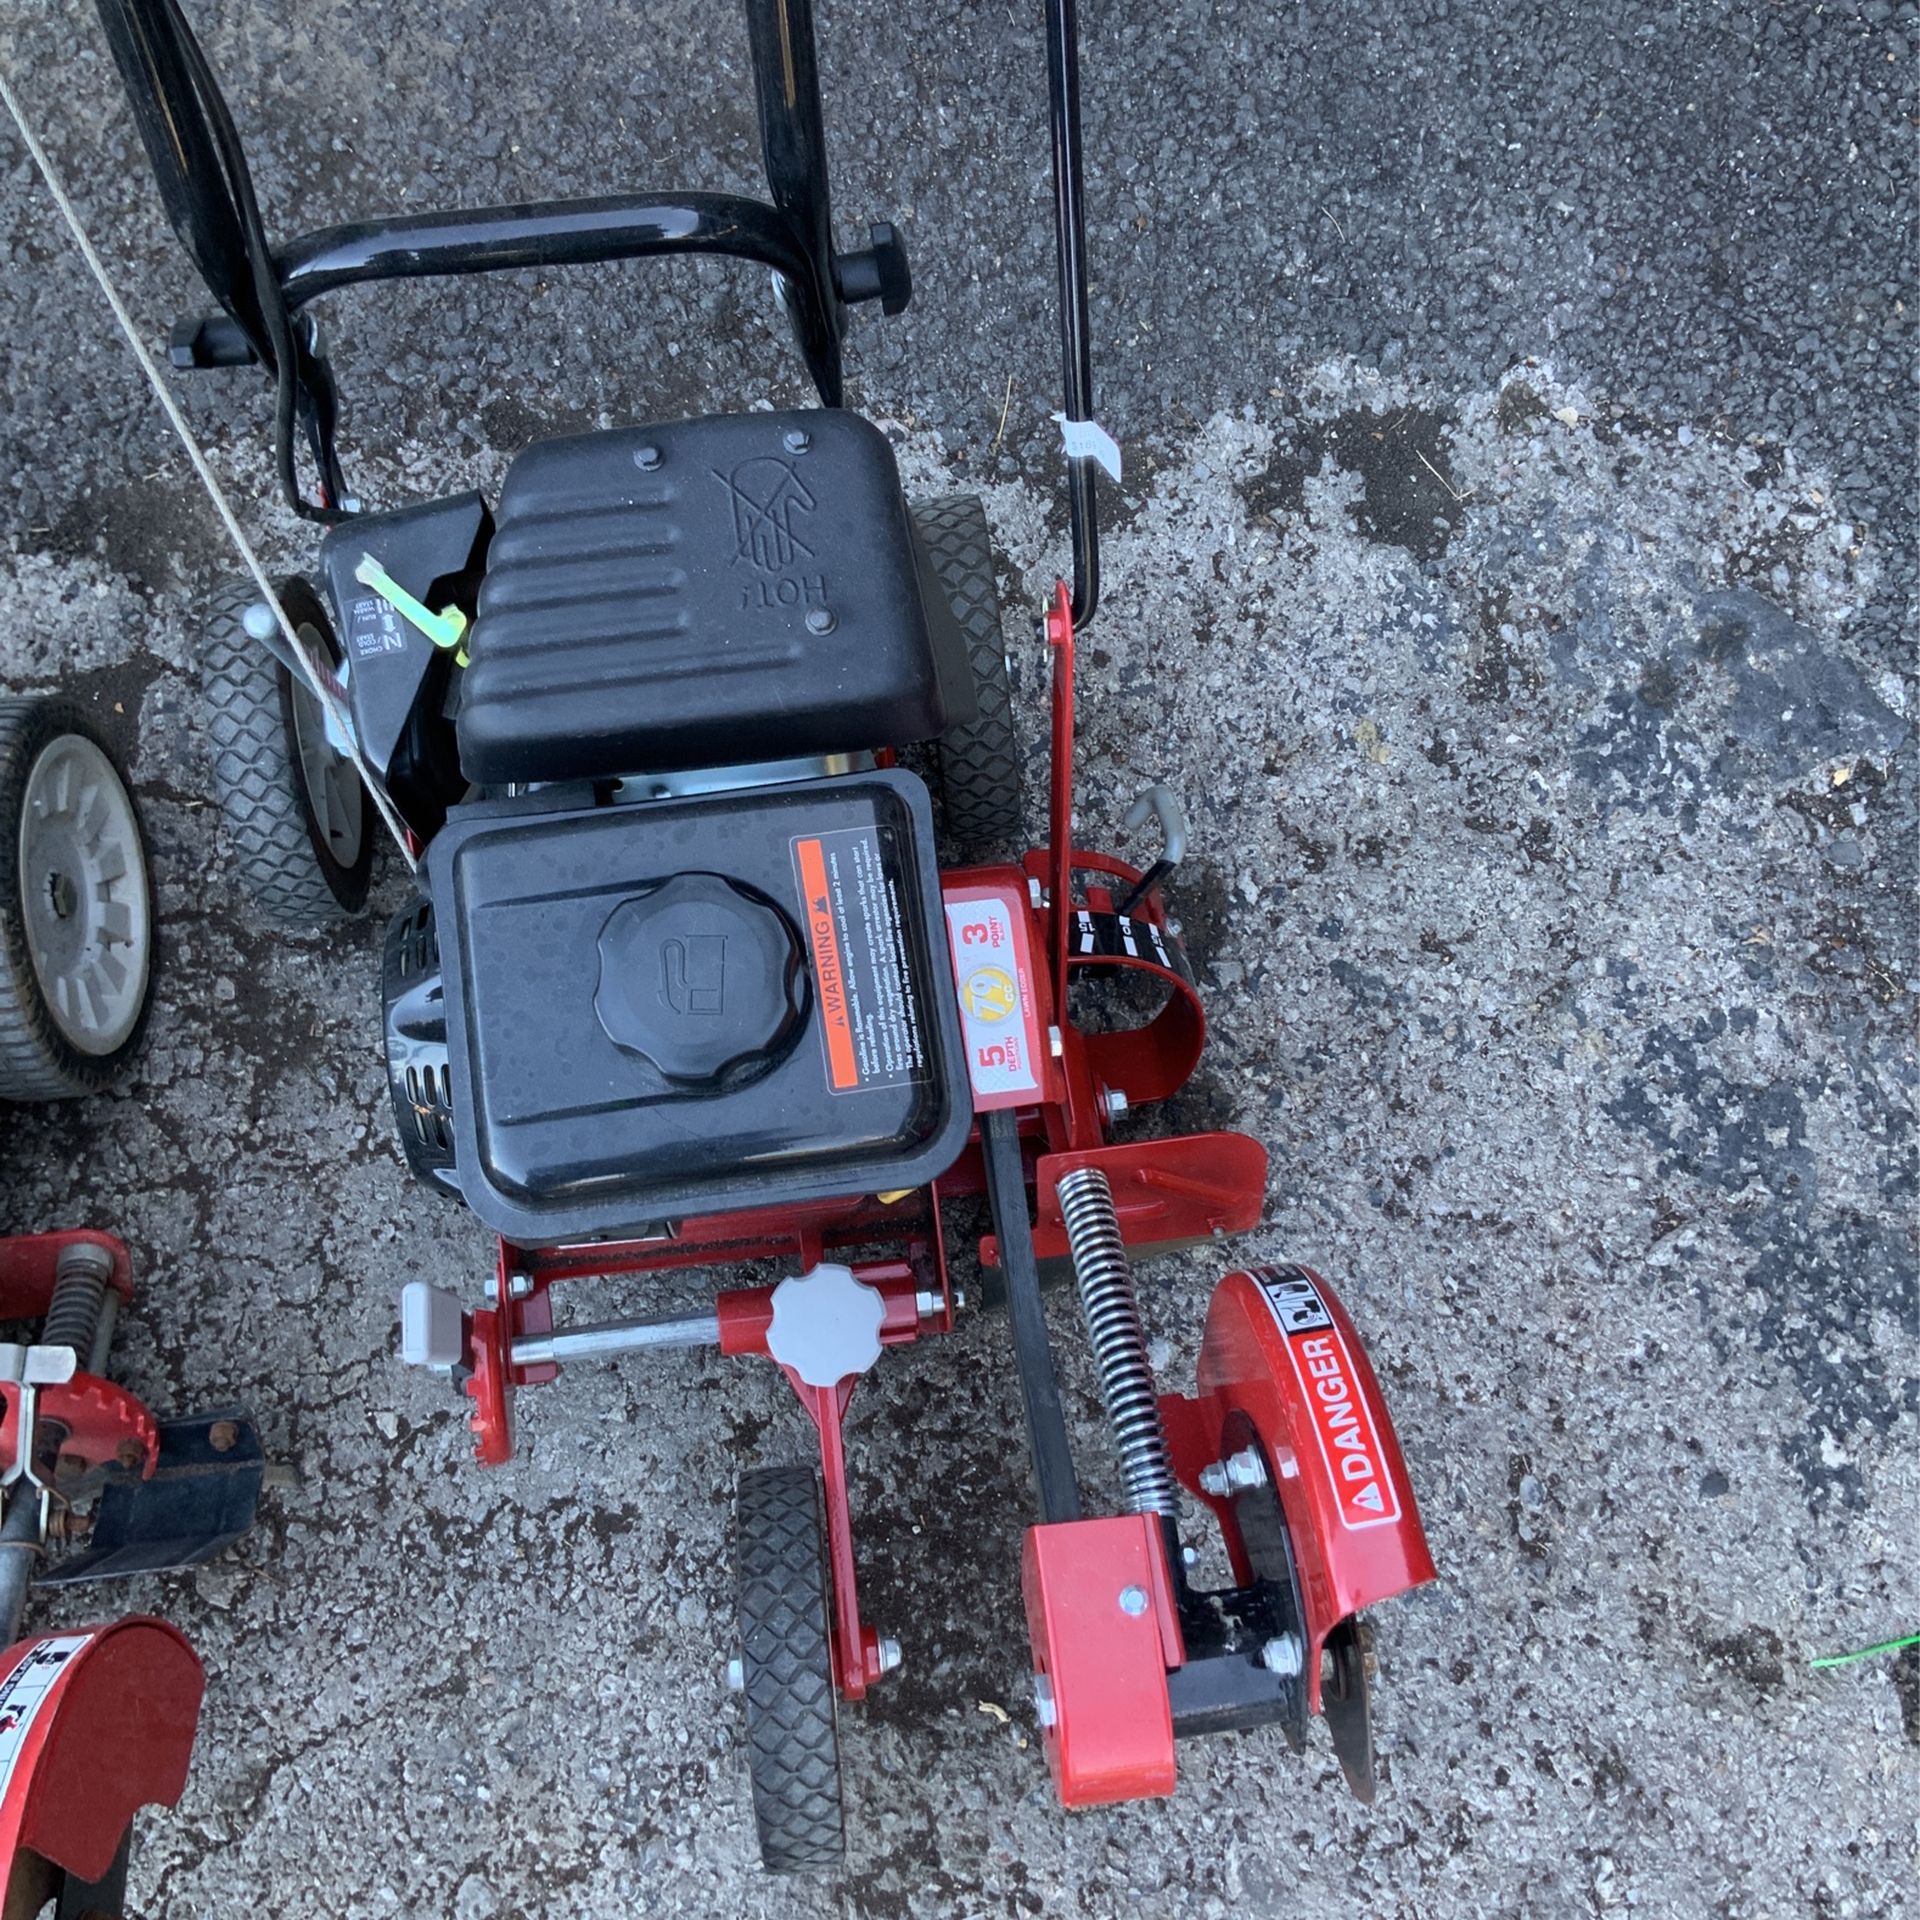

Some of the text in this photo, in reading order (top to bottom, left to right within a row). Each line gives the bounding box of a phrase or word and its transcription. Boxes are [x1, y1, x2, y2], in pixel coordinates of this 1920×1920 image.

[741, 575, 827, 610] HOT!
[828, 852, 839, 879] minutes
[833, 887, 843, 905] least
[837, 905, 845, 914] at
[838, 915, 847, 931] cool
[841, 932, 849, 941] to
[960, 922, 989, 946] 3
[987, 915, 1001, 948] POINT
[1078, 922, 1096, 932] 15
[1122, 926, 1132, 935] 0
[814, 919, 842, 1012] WARNING
[842, 941, 855, 967] engine
[851, 846, 895, 1071] Operation of this equipment may create sparks that can start
[859, 837, 904, 1070] fires around dry vegetation. A spark arrestor may be required.
[873, 851, 914, 1069] The operator should contact local fire agencies for laws or
[846, 968, 856, 990] Allow
[887, 877, 924, 1067] regulations relating to fire prevention requirements.
[967, 970, 1006, 1018] 79
[1021, 993, 1031, 1017] LAWN
[849, 991, 863, 1032] flammable.
[857, 1041, 870, 1075] Gasoline
[863, 1012, 880, 1074] before refueling.
[976, 1043, 1007, 1069] 5
[1003, 1035, 1018, 1072] DEPTH
[1303, 1337, 1374, 1482] DANGER
